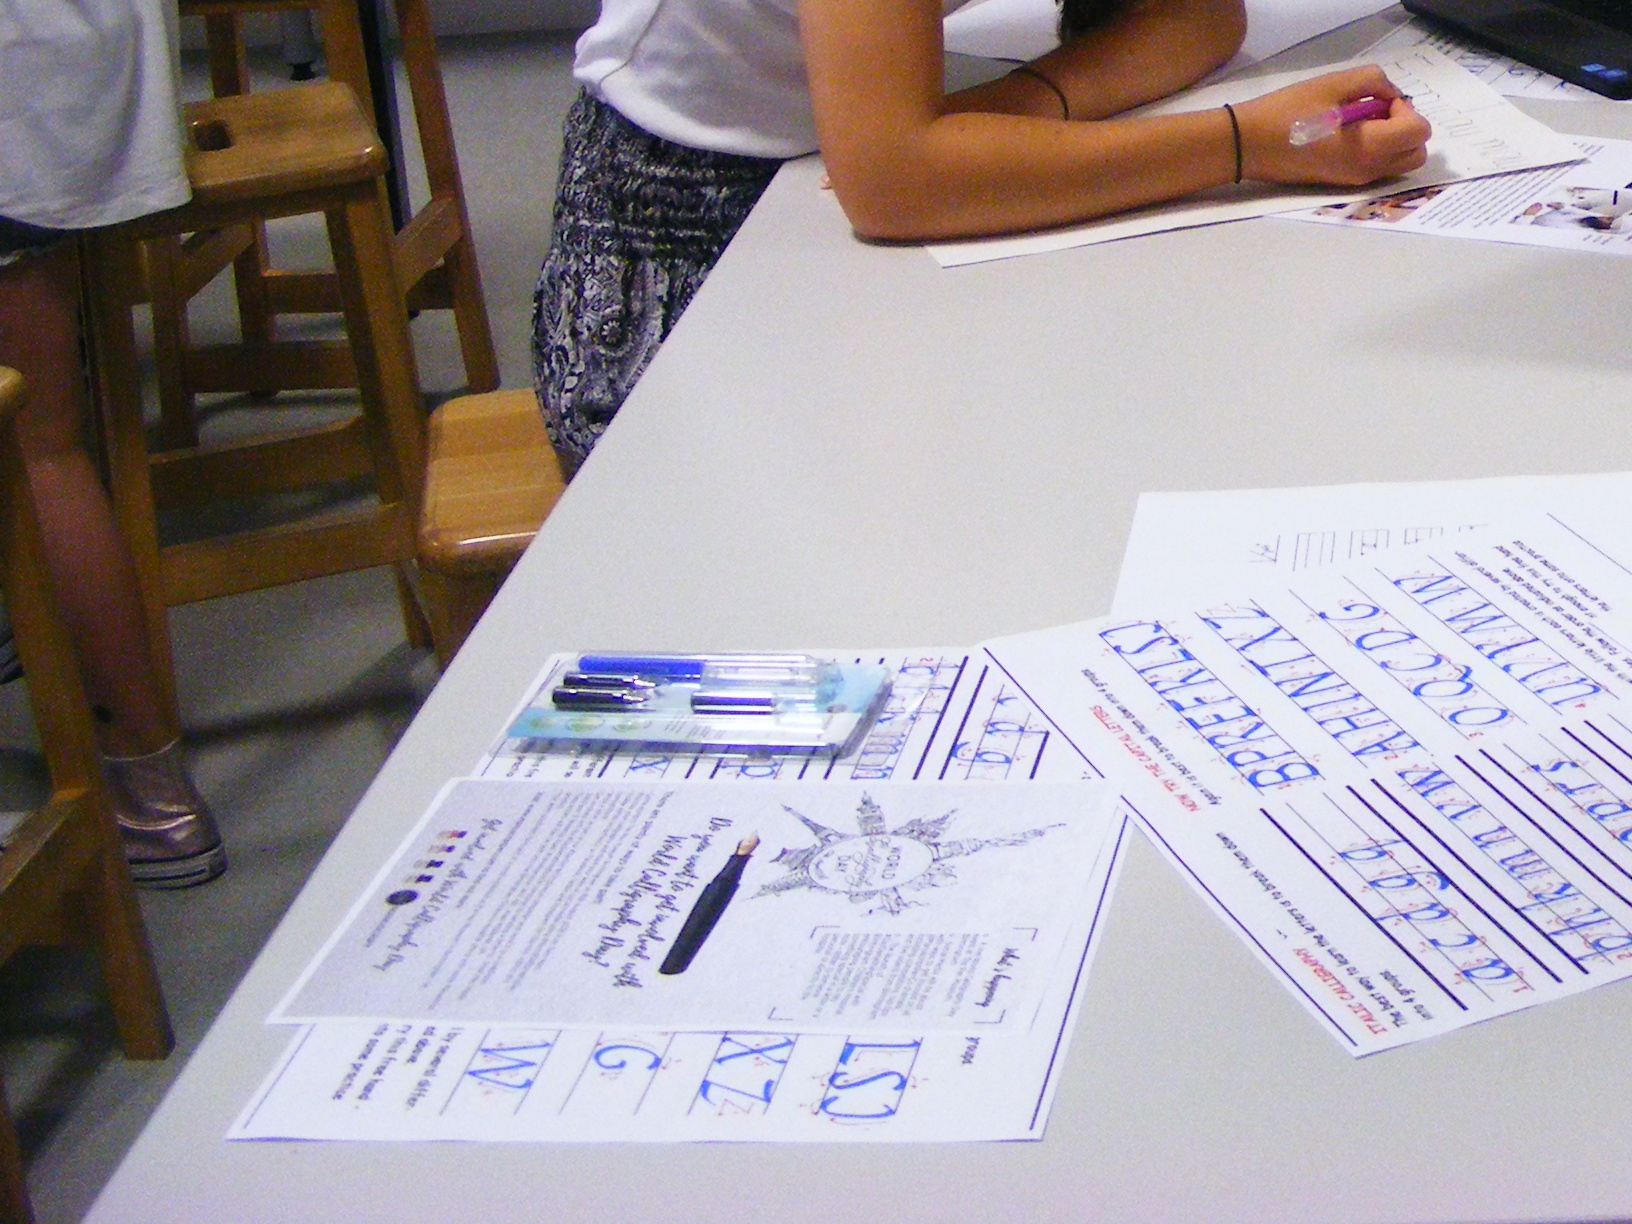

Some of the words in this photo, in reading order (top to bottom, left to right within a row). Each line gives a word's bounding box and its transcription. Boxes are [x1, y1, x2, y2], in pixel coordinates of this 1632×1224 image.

[1091, 706, 1123, 732] LETTERS
[1120, 734, 1151, 761] CAPITAL
[1145, 763, 1159, 777] THE
[1163, 780, 1176, 792] TRY
[709, 817, 732, 831] Do
[649, 834, 694, 866] World
[691, 834, 713, 852] you
[1216, 833, 1237, 849] down
[675, 855, 698, 879] want
[1233, 851, 1250, 869] them
[670, 881, 694, 892] to
[1252, 870, 1276, 891] break
[600, 869, 665, 932] Calligraphy
[654, 894, 679, 912] get
[1272, 891, 1282, 900] to
[1288, 908, 1316, 933] letters
[629, 914, 665, 960] involved
[1313, 934, 1326, 947] the
[1327, 949, 1349, 966] learn
[614, 963, 642, 988] with
[1296, 949, 1353, 1000] CALLIGRAPHY
[1346, 967, 1358, 976] to
[1359, 977, 1374, 991] way
[1370, 993, 1394, 1011] best
[1414, 1004, 1432, 1020] into
[1348, 1003, 1387, 1034] ITALIC
[1390, 1011, 1402, 1027] The
[358, 1039, 379, 1060] some
[387, 1037, 406, 1054] this
[714, 1036, 796, 1066] X
[837, 1040, 922, 1066] L
[373, 1057, 396, 1076] free
[424, 1045, 449, 1076] several
[465, 1041, 554, 1091] W
[591, 1044, 663, 1071] G
[358, 1079, 381, 1100] hand
[827, 1070, 908, 1092] S
